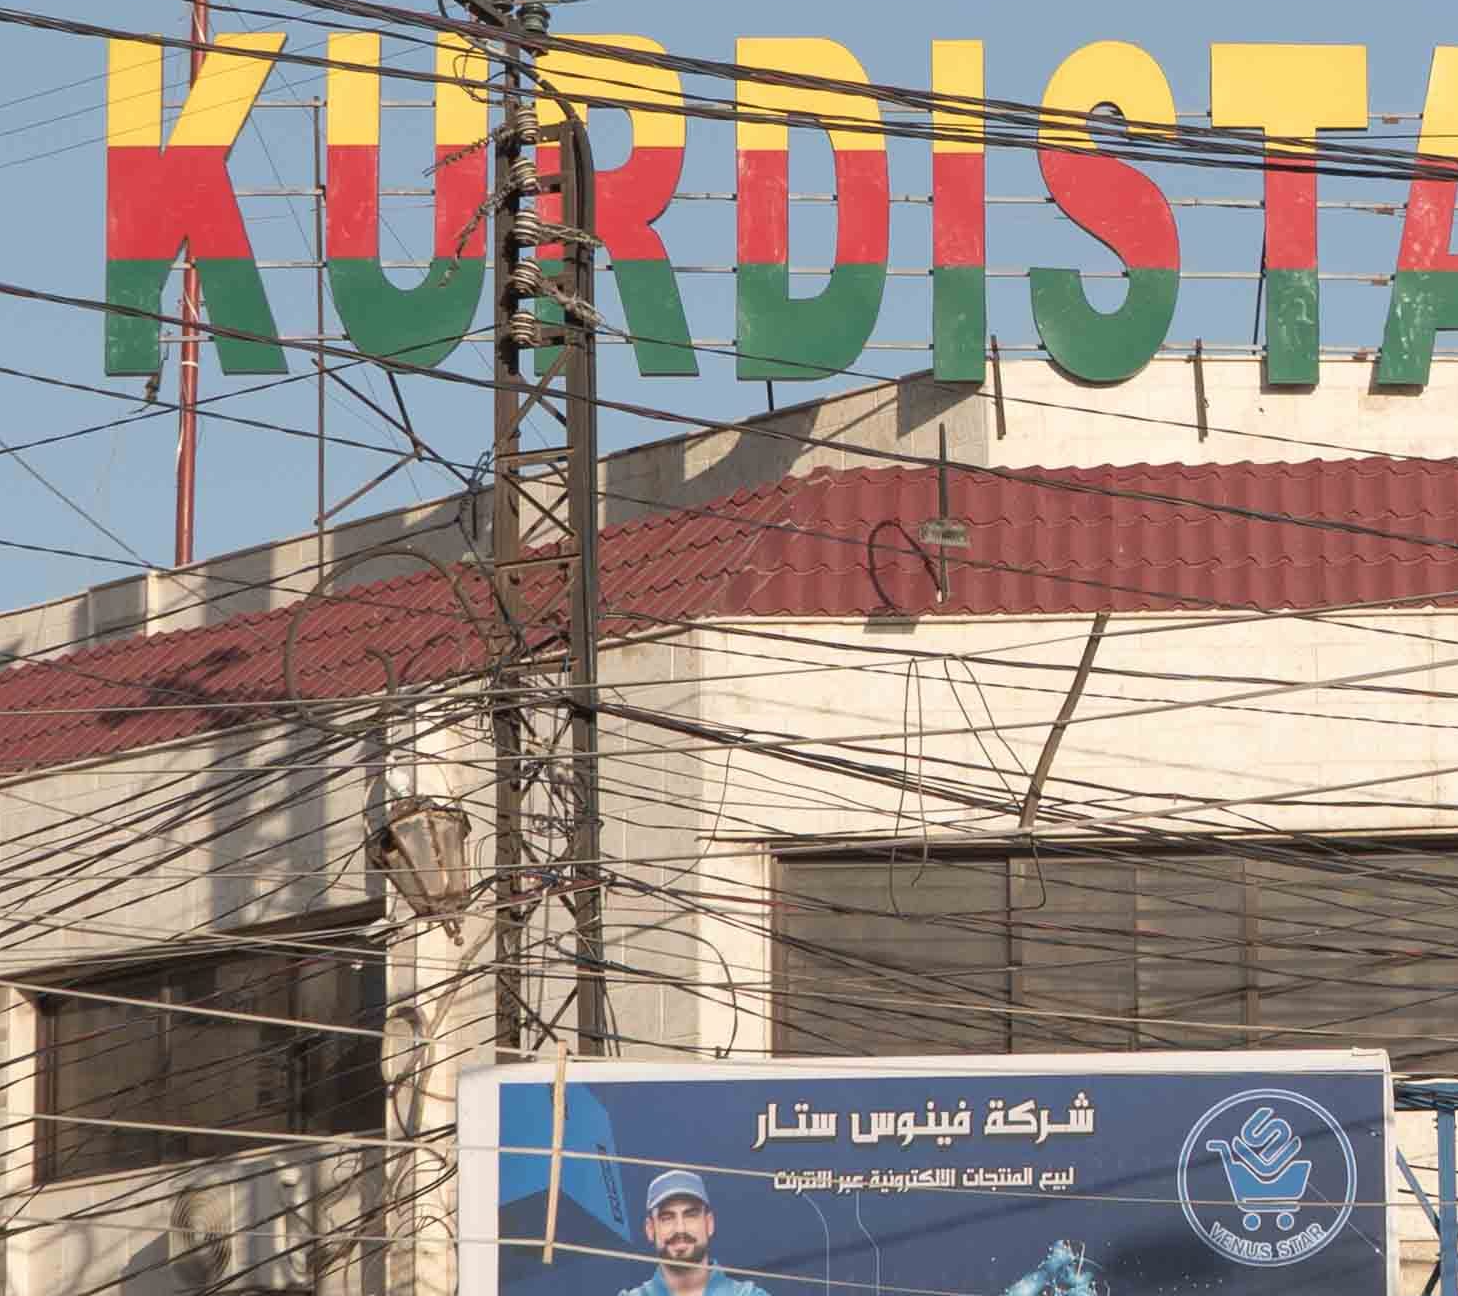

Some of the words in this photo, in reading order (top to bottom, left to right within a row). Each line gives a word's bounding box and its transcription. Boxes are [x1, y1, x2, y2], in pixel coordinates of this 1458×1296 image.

[751, 1102, 838, 1149] ستار
[850, 1101, 973, 1147] فينوس
[984, 1092, 1095, 1144] شركة
[837, 1174, 867, 1194] عبر
[962, 1167, 1033, 1192] المنتجات
[1039, 1166, 1075, 1192] لبيع
[1208, 1221, 1273, 1260] VENUS
[1276, 1223, 1328, 1258] STAR
